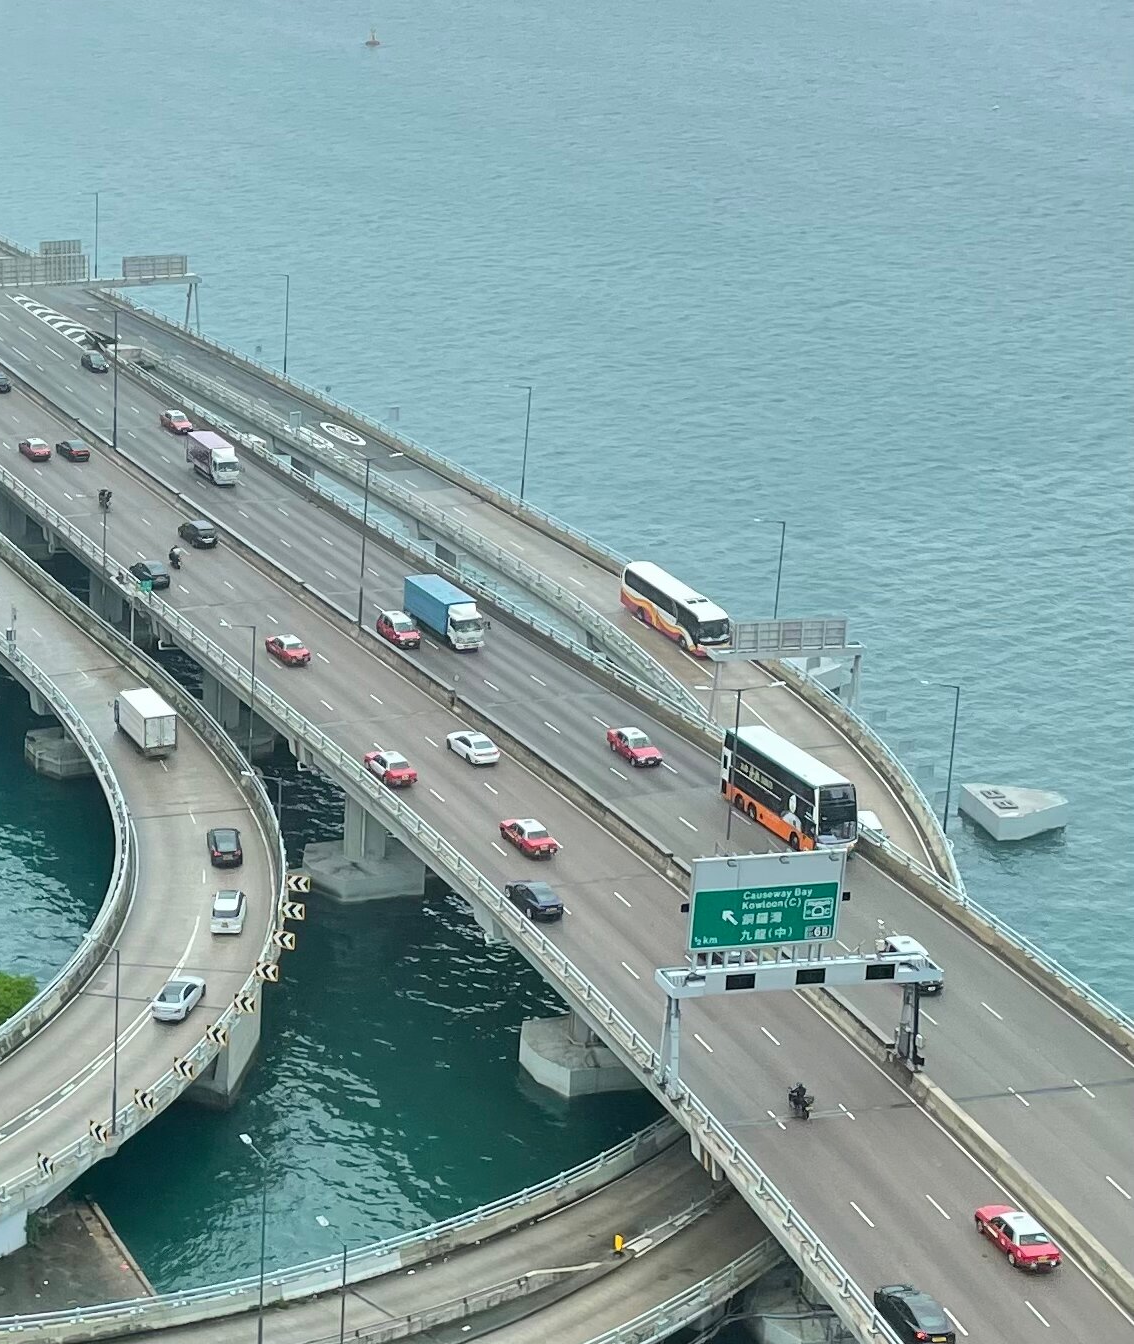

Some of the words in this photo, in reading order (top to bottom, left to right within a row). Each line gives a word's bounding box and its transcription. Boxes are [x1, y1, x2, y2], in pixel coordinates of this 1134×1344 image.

[743, 890, 792, 901] Causeway
[794, 887, 813, 897] Bay
[703, 935, 718, 945] km
